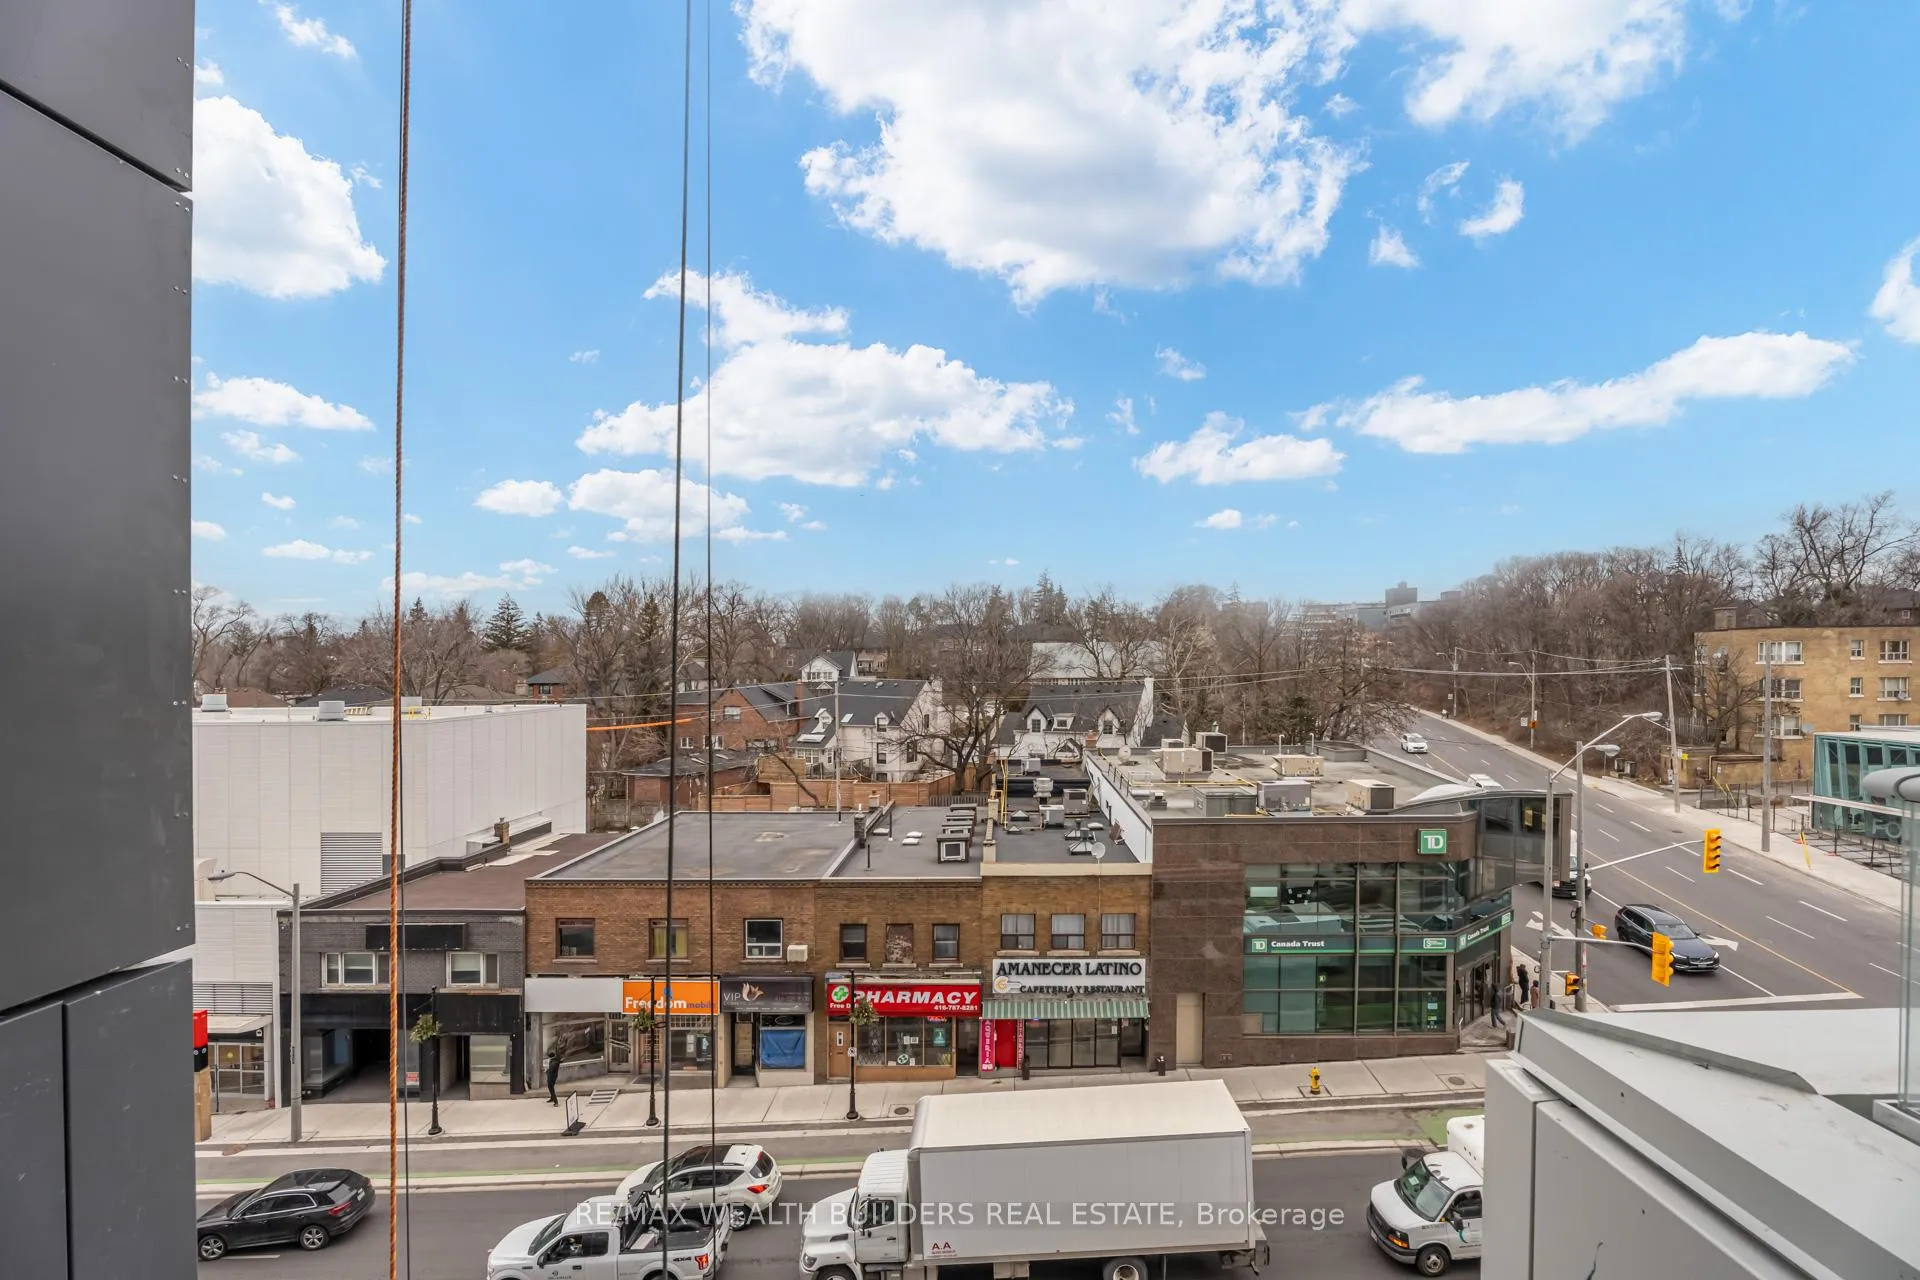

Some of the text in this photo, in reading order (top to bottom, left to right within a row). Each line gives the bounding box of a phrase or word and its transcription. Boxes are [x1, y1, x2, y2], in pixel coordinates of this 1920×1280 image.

[1423, 835, 1444, 849] TD
[1253, 942, 1266, 950] TD
[996, 962, 1142, 976] AMANECER LATINO
[1075, 985, 1082, 994] Y
[1083, 985, 1144, 994] RESTAURANT
[723, 992, 741, 1001] VIP
[853, 991, 977, 1004] PHARMACY
